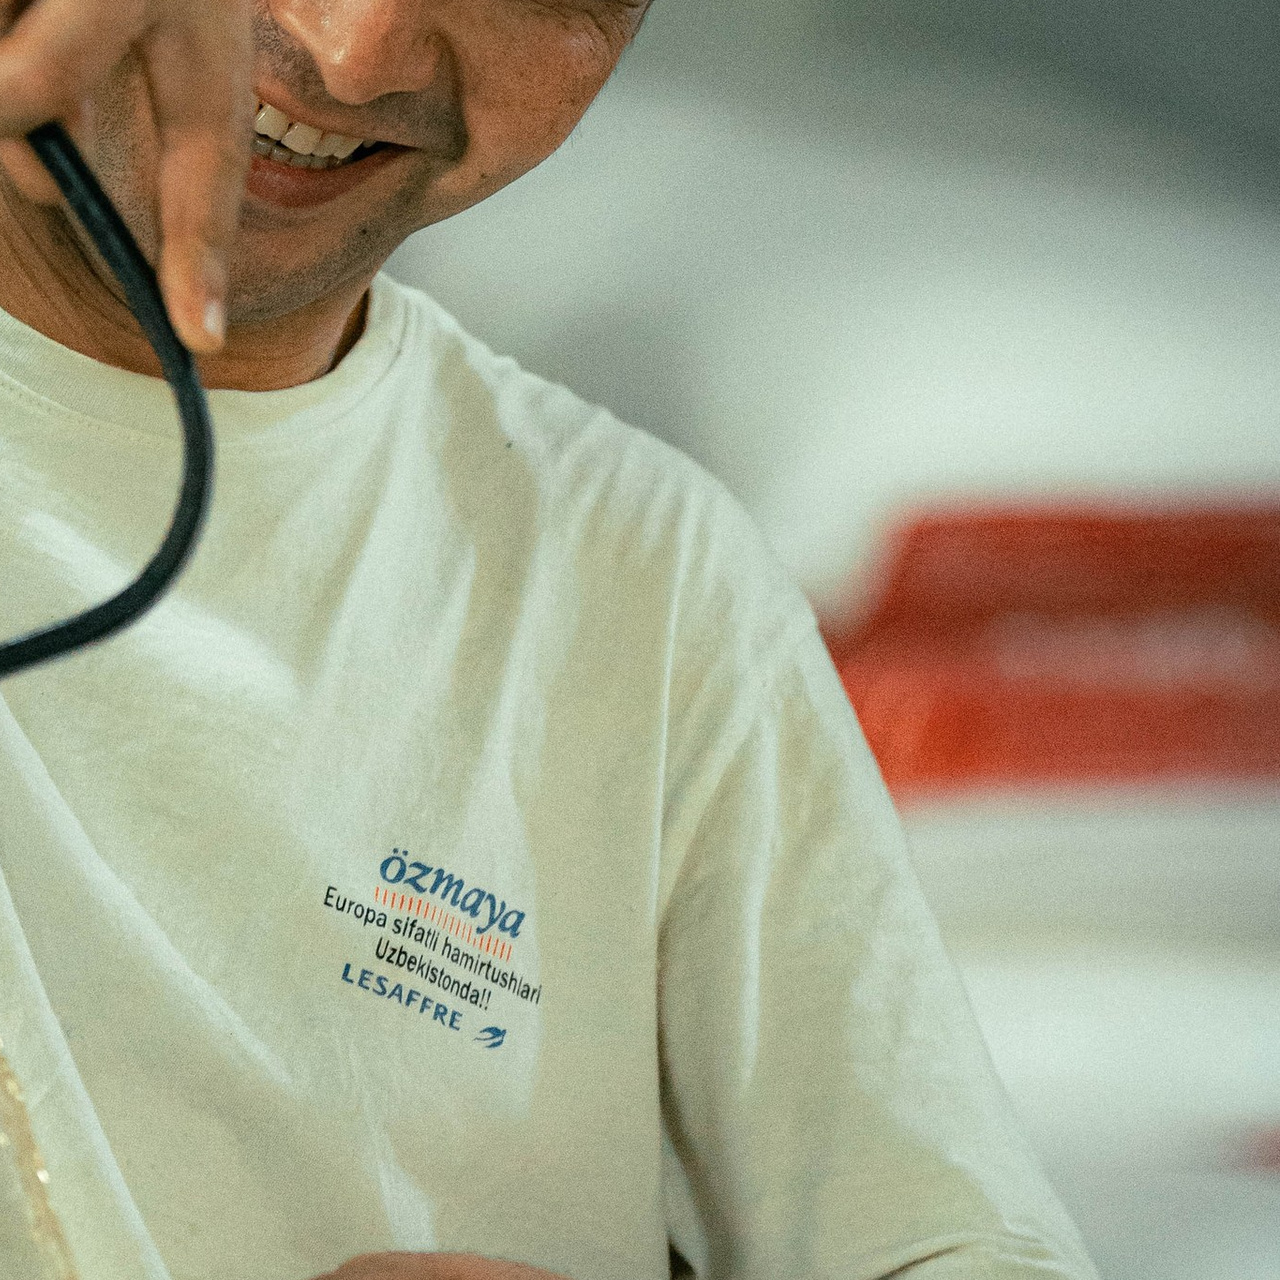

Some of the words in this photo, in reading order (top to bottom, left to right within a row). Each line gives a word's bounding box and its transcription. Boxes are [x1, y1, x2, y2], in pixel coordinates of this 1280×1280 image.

[380, 848, 526, 938] özmaya
[323, 886, 387, 927] Europa
[392, 917, 440, 951] sifatli
[441, 936, 542, 1005] hamirtushlari
[375, 937, 492, 1010] Uzbekistonda!!
[341, 963, 463, 1031] LESAFFRE
